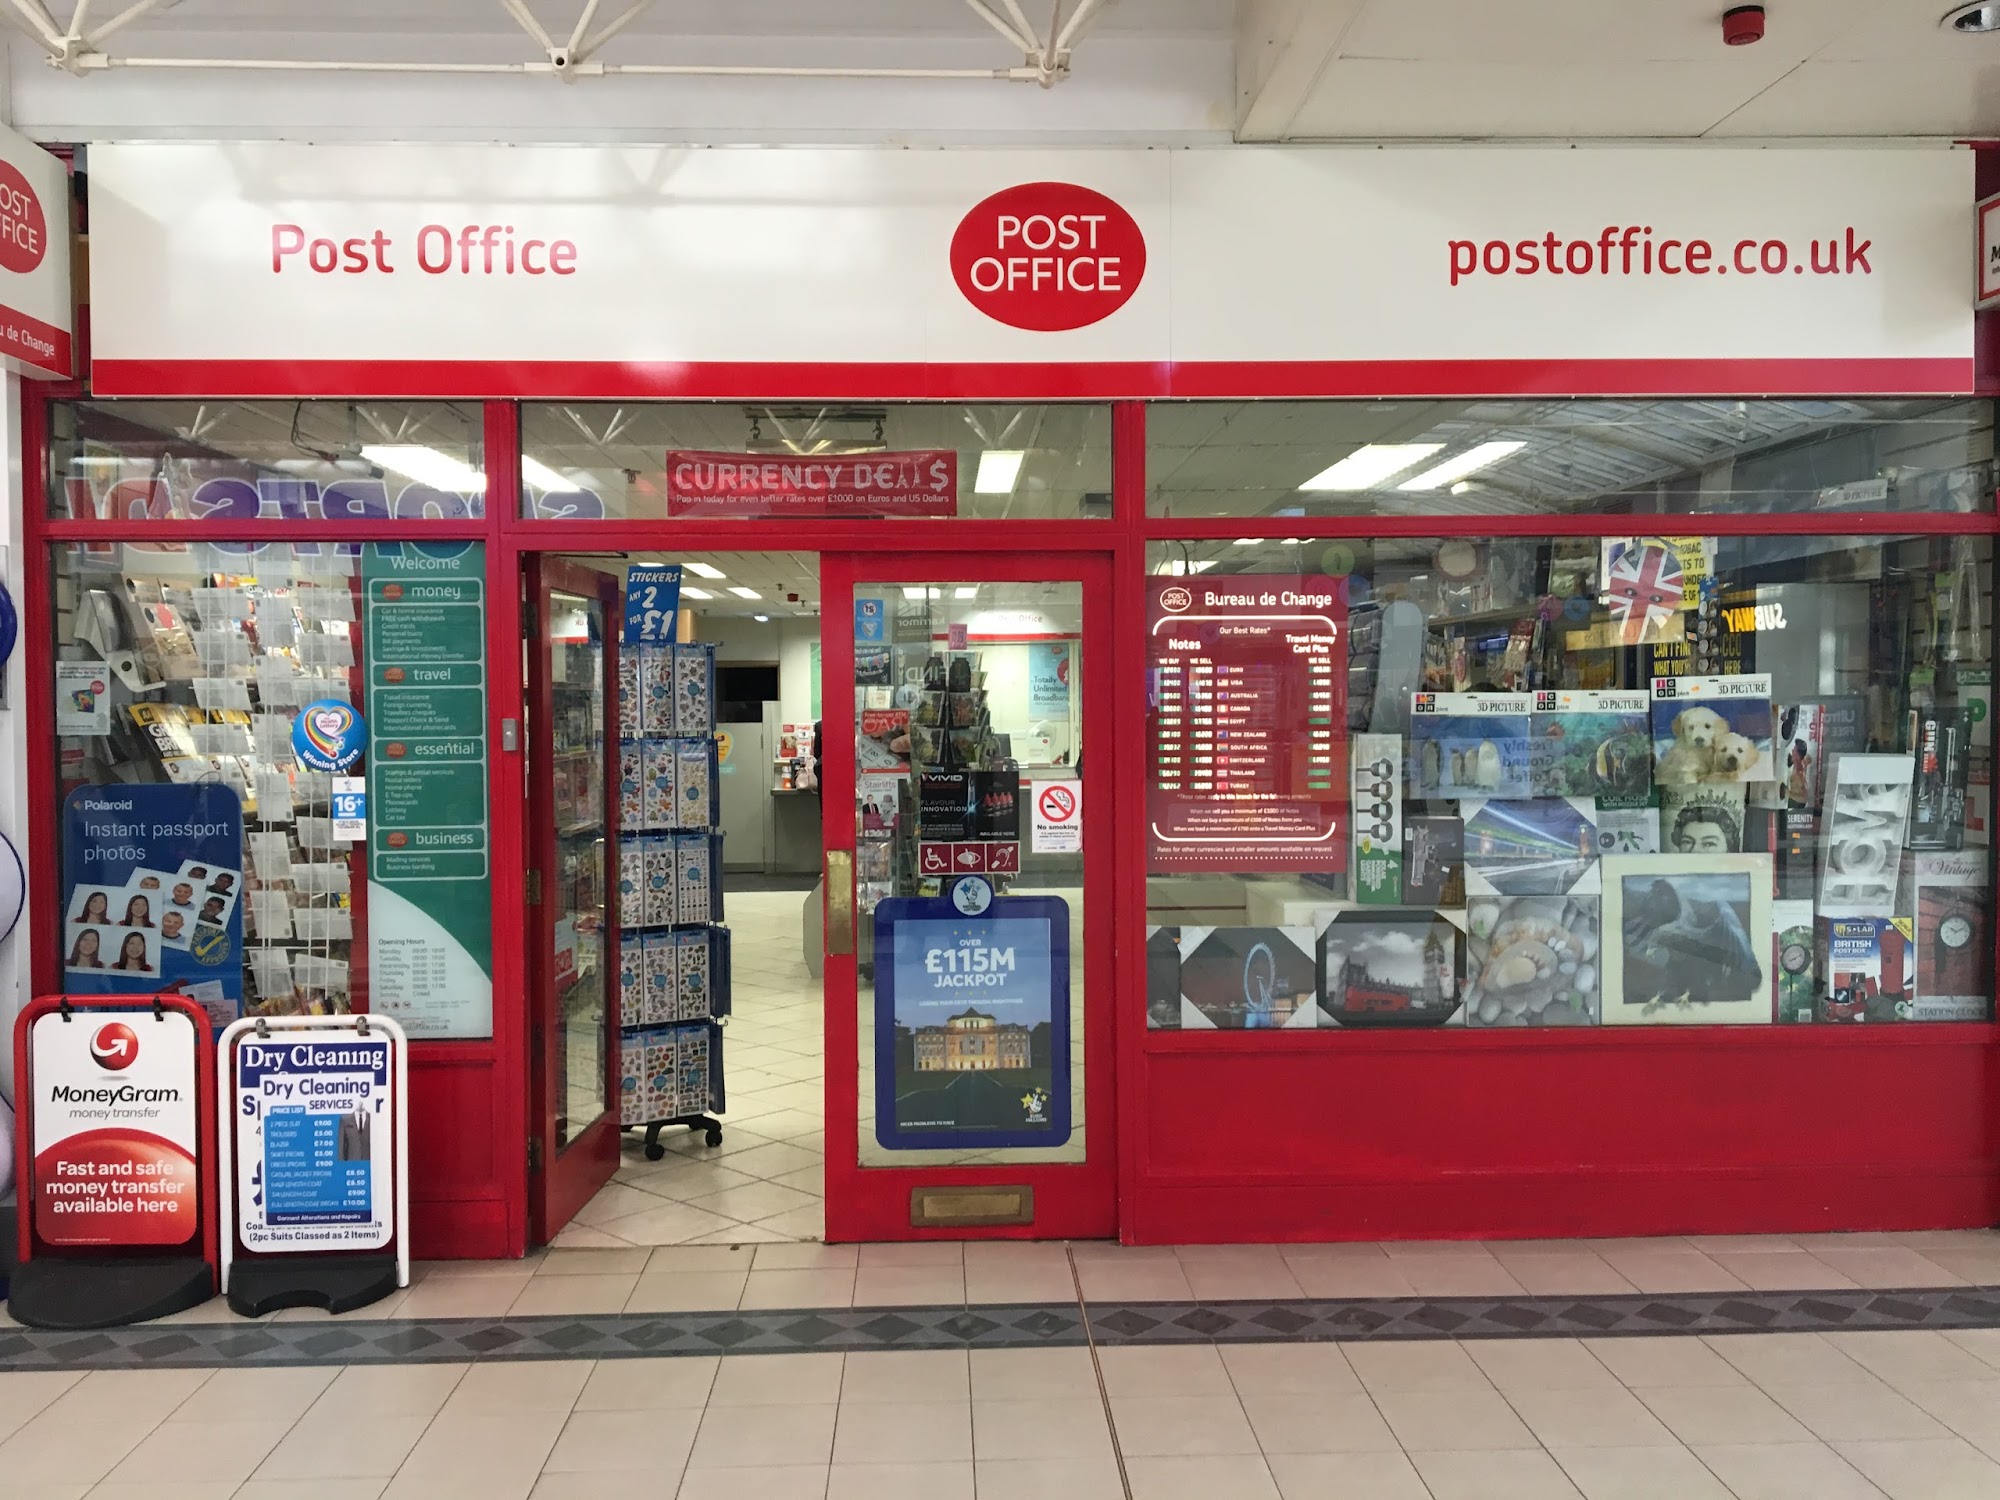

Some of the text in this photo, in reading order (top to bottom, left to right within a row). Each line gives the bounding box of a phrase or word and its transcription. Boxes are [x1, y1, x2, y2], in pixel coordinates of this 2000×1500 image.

[997, 214, 1106, 250] POST
[271, 224, 578, 274] Post Office
[1448, 226, 1872, 286] postoffice.co.uk
[970, 256, 1121, 292] OFFICE
[7, 324, 19, 340] de
[21, 329, 55, 357] Change
[675, 463, 842, 490] CURRENCY
[676, 494, 691, 504] Pop
[693, 494, 701, 503] in
[703, 494, 724, 504] today
[727, 495, 738, 503] for
[740, 495, 758, 503] even
[760, 494, 784, 503] better
[786, 494, 806, 503] rates
[808, 495, 824, 503] over
[827, 494, 853, 503] £1000
[868, 494, 889, 503] Euros
[893, 494, 906, 503] and
[909, 494, 920, 503] US
[922, 494, 949, 503] Dollars
[390, 558, 461, 570] Welcome
[1694, 559, 1705, 569] TO
[629, 572, 679, 583] STICKERS
[411, 586, 461, 599] money
[629, 586, 657, 608] ANY 2
[1205, 591, 1332, 608] Bureau de Change
[629, 609, 674, 640] FOR £1
[1219, 627, 1232, 635] Our
[1169, 634, 1335, 650] Notes Travel Money
[1293, 645, 1329, 653] Card Plus
[413, 668, 451, 680] travel
[1653, 660, 1670, 675] WHAT
[1034, 676, 1057, 684] Totally
[1719, 683, 1767, 694] 3D PICTURE
[1477, 703, 1526, 712] 3D PICTURE
[1598, 699, 1644, 709] 3D PICTURE
[1924, 720, 1937, 751] GUN
[414, 743, 474, 755] essential
[302, 748, 359, 770] Winning Store
[864, 780, 896, 788] Stairlifts
[84, 800, 132, 811] Polaroid
[334, 796, 364, 813] 16+
[1787, 814, 1813, 823] SERENITY
[84, 820, 229, 840] Instant passport
[416, 832, 474, 844] business
[84, 845, 146, 865] photos
[959, 939, 981, 947] OVER
[1834, 940, 1872, 948] BRITISH
[924, 947, 1016, 974] £115M
[934, 973, 1007, 989] JACKPOT
[1919, 1007, 1954, 1016] STATION
[245, 1045, 384, 1071] Dry Cleaning
[51, 1085, 179, 1107] MoneyGram
[264, 1077, 370, 1100] Dry Cleaning
[309, 1099, 353, 1110] SERVICES
[69, 1106, 160, 1120] money transfer
[56, 1160, 173, 1175] Fast and safe
[46, 1179, 185, 1197] money transfer
[53, 1198, 178, 1213] available here
[249, 1232, 269, 1243] (2pc
[270, 1231, 293, 1240] Suits
[294, 1231, 331, 1240] Classed
[343, 1231, 350, 1239] 2
[350, 1230, 380, 1240] Items)
